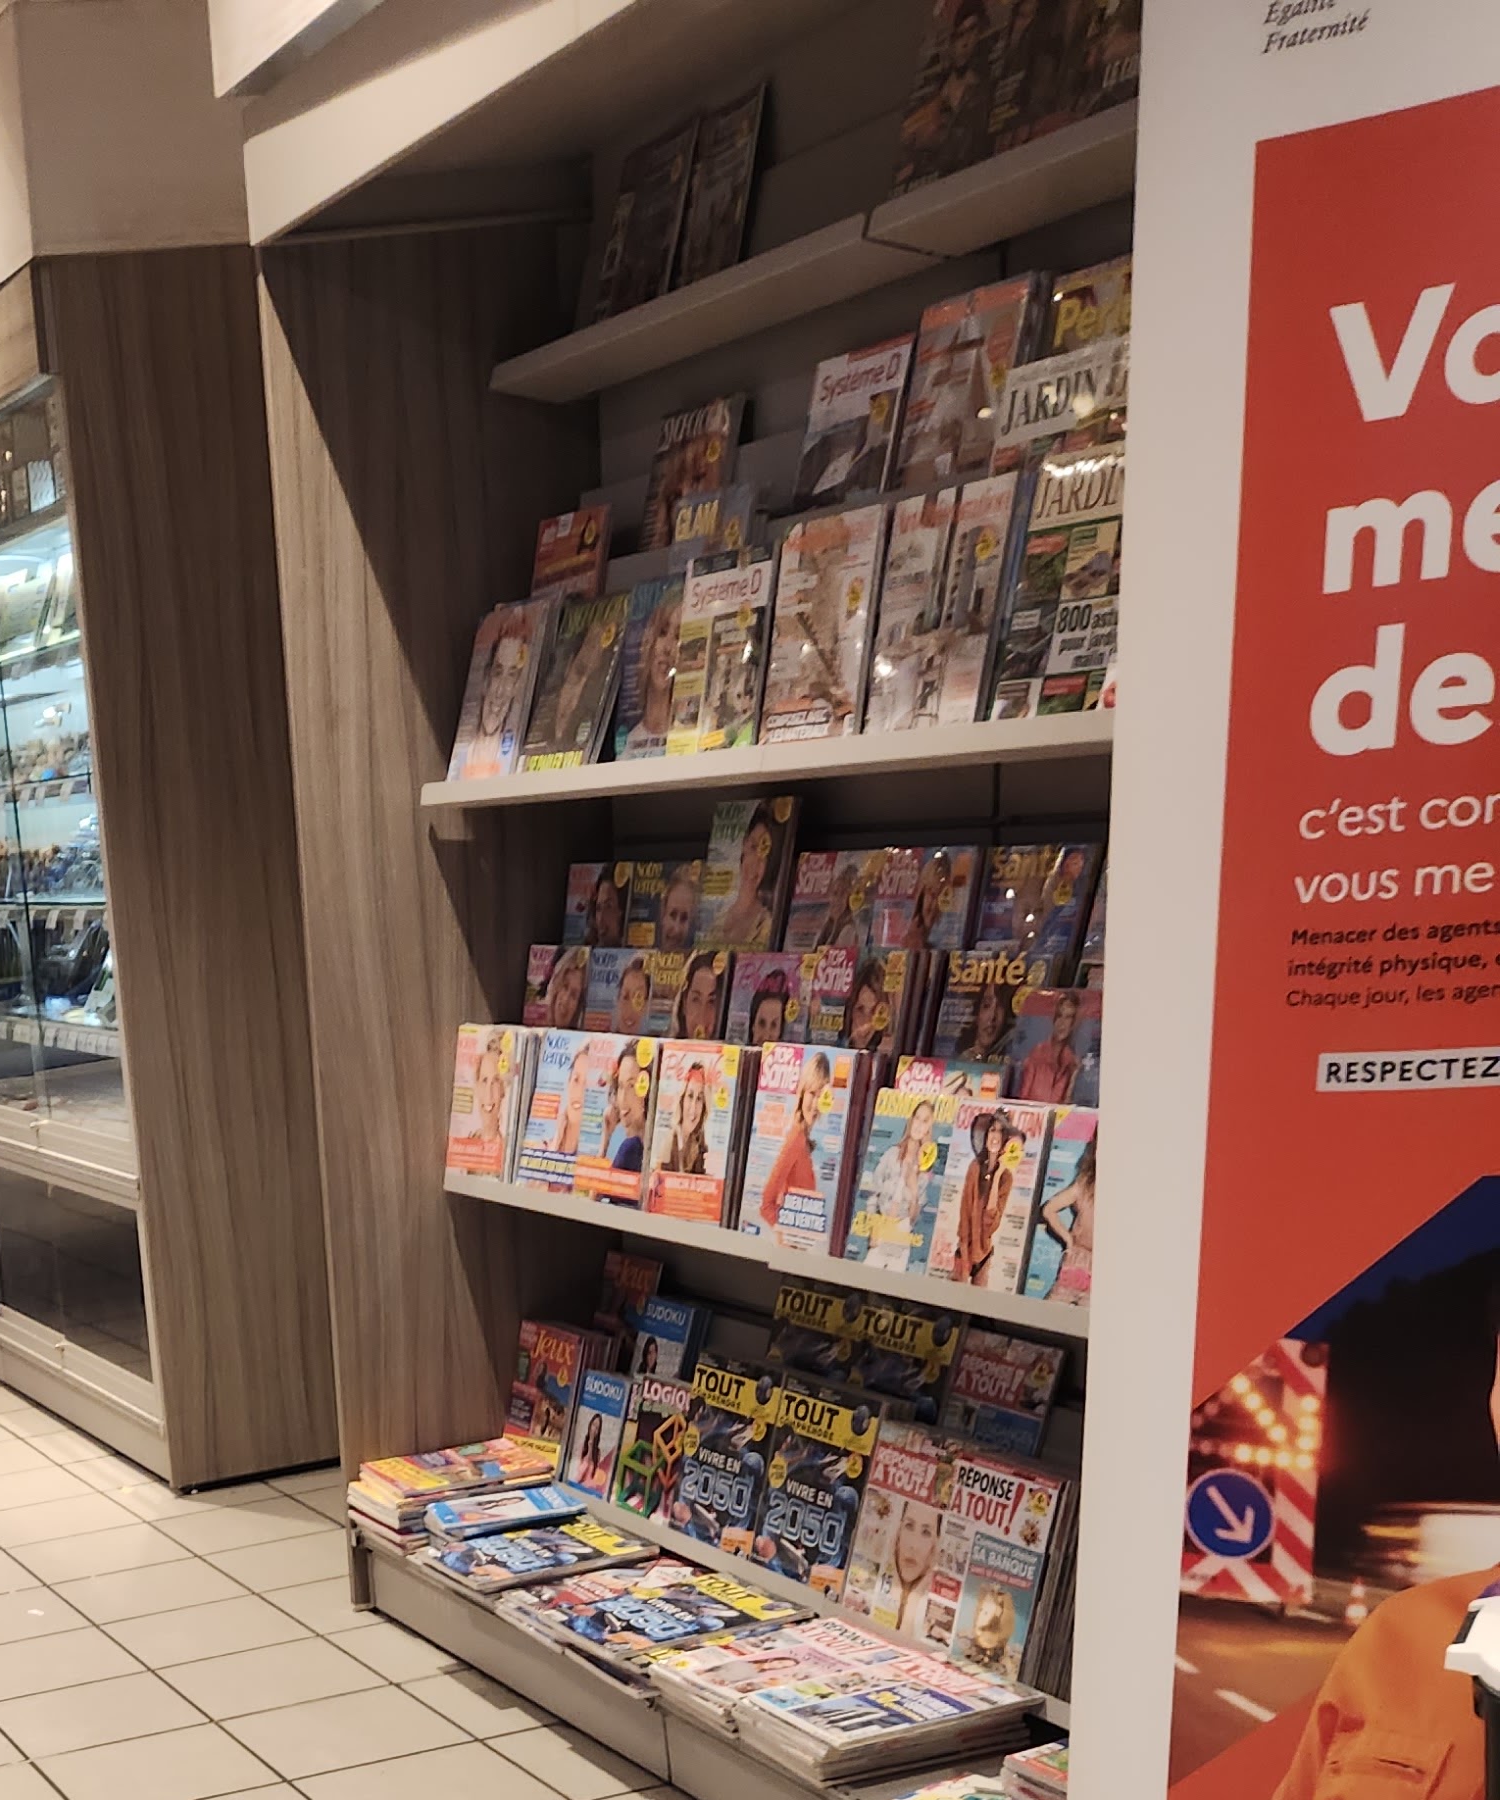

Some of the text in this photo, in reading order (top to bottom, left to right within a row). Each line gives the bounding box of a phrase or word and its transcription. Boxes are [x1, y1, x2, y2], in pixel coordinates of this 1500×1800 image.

[1262, 8, 1371, 54] Fraternité
[1055, 603, 1092, 634] 800
[1298, 796, 1408, 840] c'est
[1294, 861, 1496, 904] vous me
[1291, 920, 1500, 945] Menacer des agents
[813, 960, 854, 994] Santé
[1287, 952, 1487, 979] intégrité physique,
[1286, 989, 1360, 1009] Chaque
[1362, 986, 1409, 1009] jour,
[1417, 985, 1445, 1002] les
[759, 1054, 801, 1091] Santé
[1325, 1056, 1500, 1084] RESPECTEZ
[645, 1302, 687, 1325] SUDOKU
[780, 1287, 834, 1320] TOUT
[862, 1307, 924, 1342] TOUT
[534, 1328, 575, 1366] Jeux
[583, 1374, 625, 1401] SUDOKU
[696, 1366, 746, 1399] TOUT
[783, 1392, 840, 1429] TOUT
[698, 1446, 742, 1474] VIVRE EN
[680, 1458, 750, 1518] 2050
[786, 1478, 834, 1508] VIVRE EN
[764, 1491, 846, 1555] 2050
[989, 1550, 1036, 1580] BANQUE
[697, 1574, 757, 1603] TOUT
[595, 1596, 702, 1642] 2050
